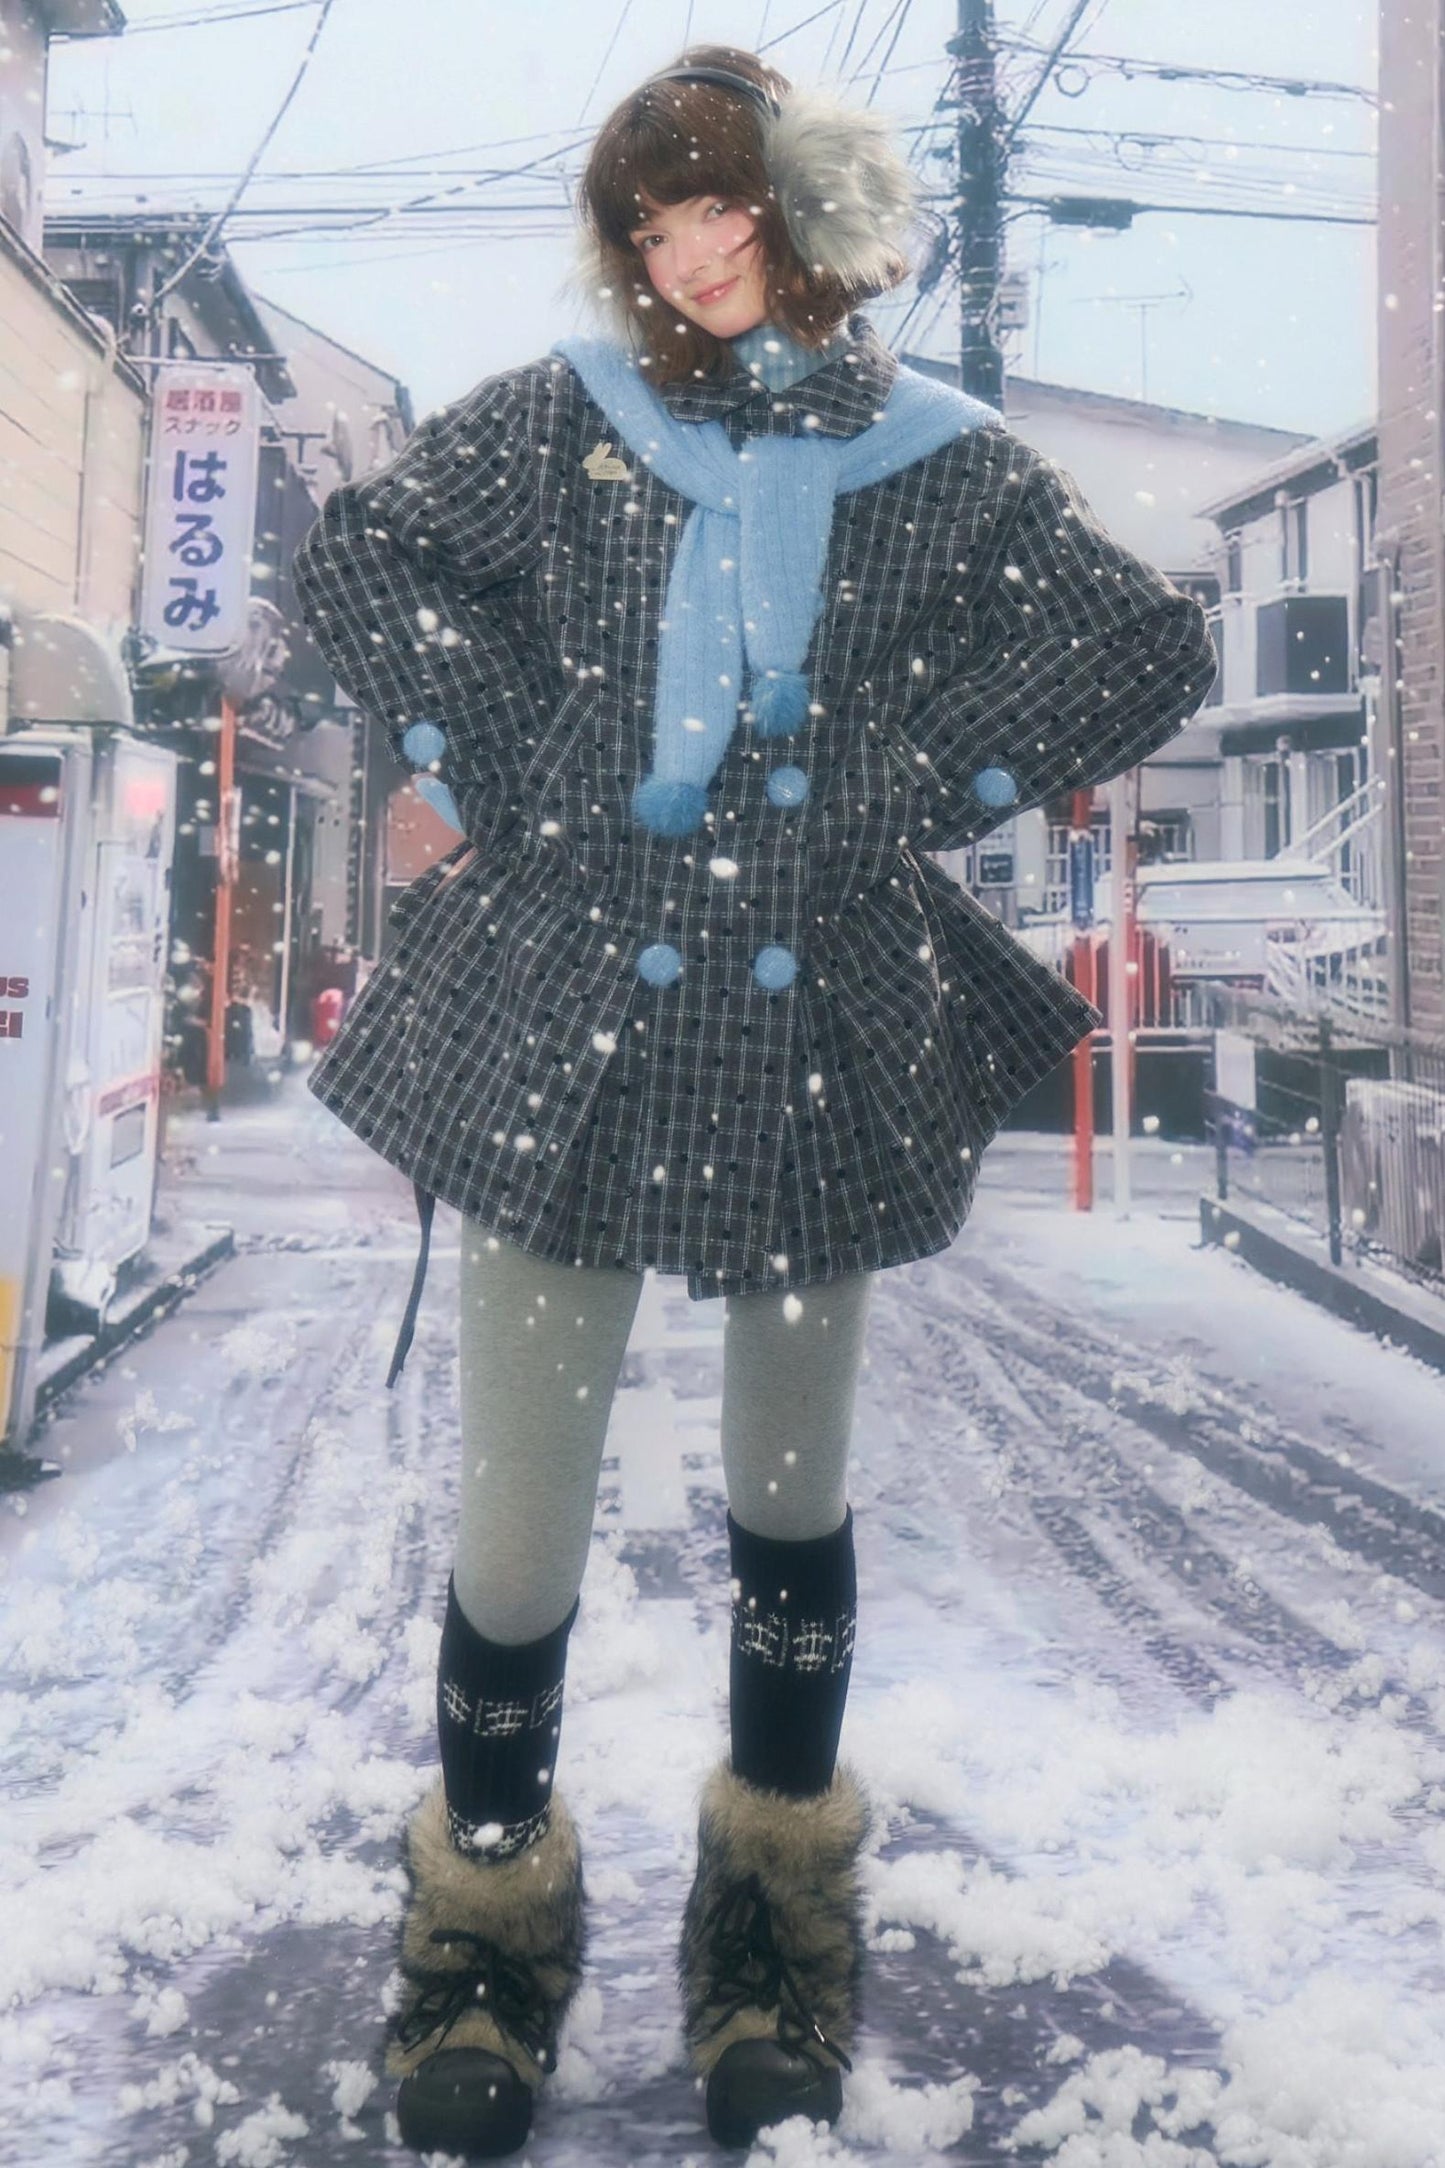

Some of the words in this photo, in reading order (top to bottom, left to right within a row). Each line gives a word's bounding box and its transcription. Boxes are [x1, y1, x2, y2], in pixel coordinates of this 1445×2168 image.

[165, 416, 241, 436] スナック
[163, 450, 227, 631] はるみ
